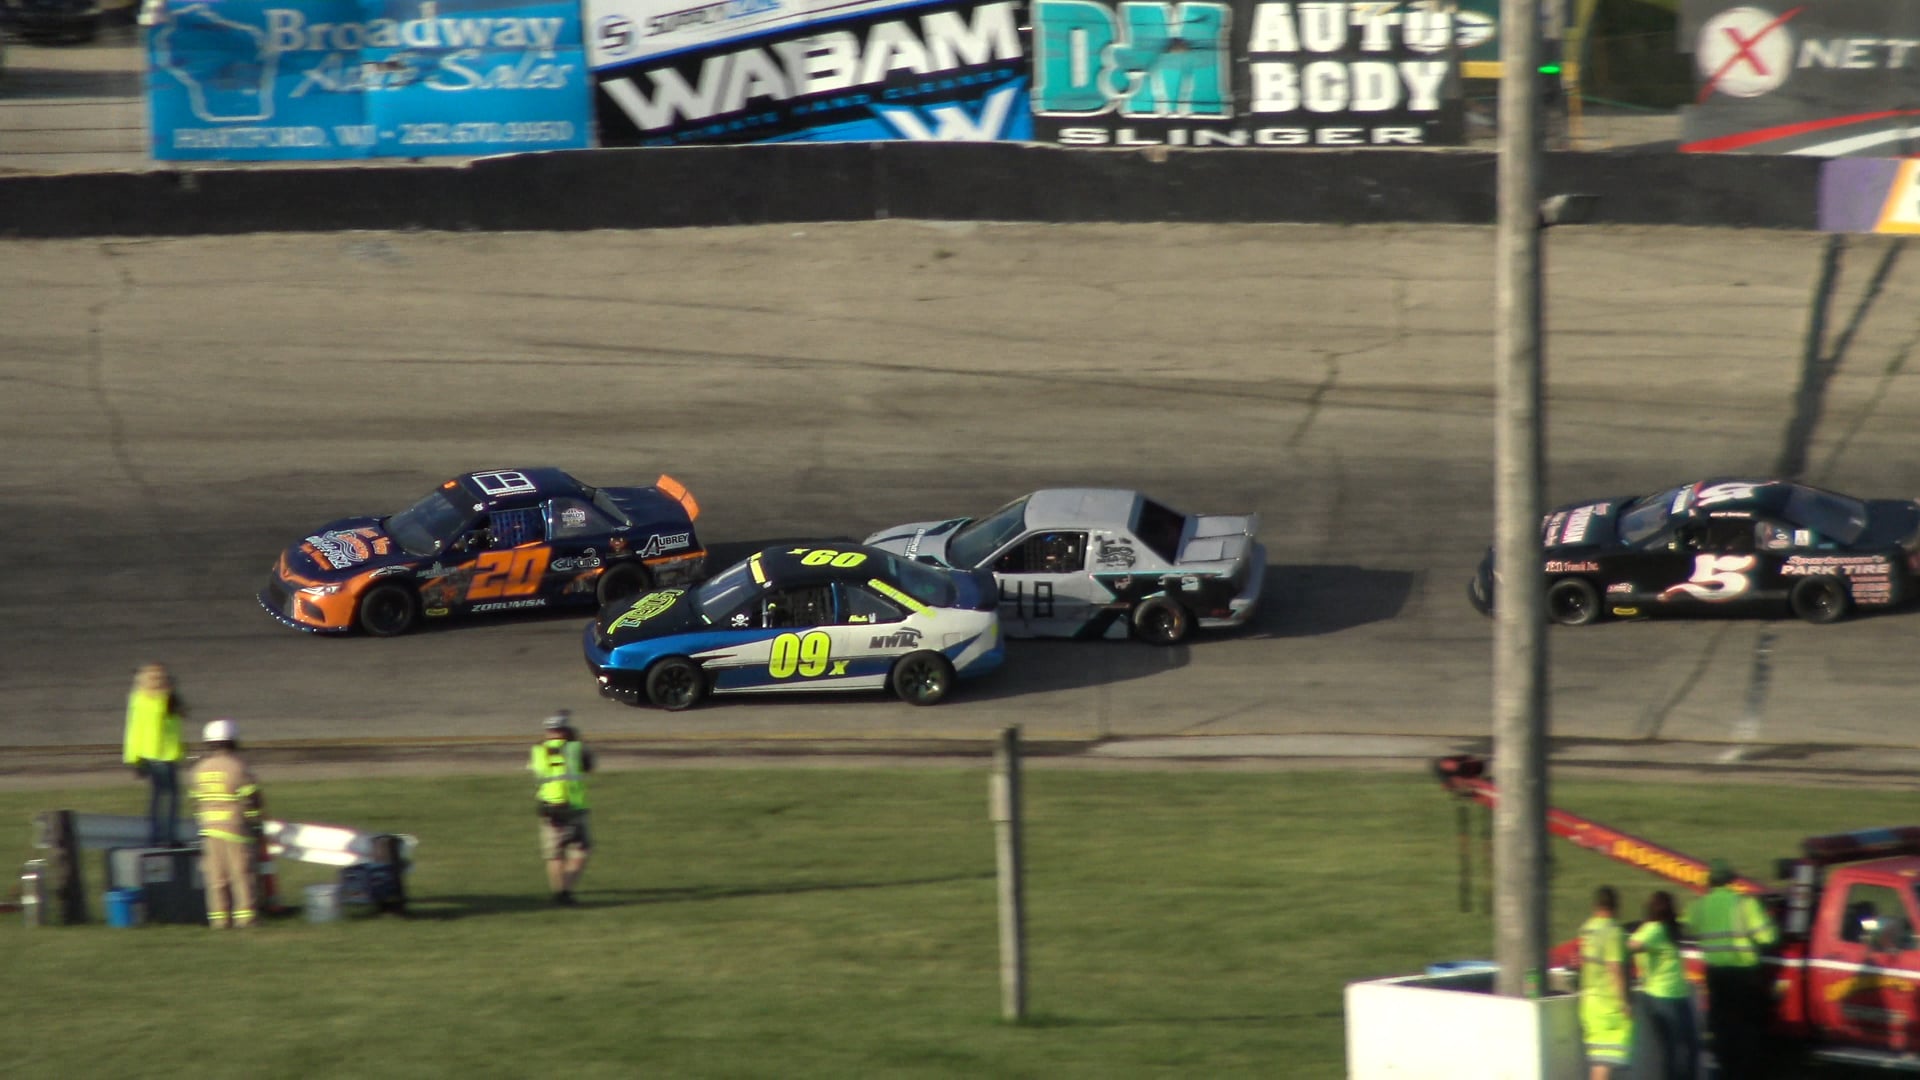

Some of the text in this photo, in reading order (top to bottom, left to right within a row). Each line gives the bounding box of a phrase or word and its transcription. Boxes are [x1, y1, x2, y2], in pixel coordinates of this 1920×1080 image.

[264, 2, 565, 58] Broadway
[602, 2, 1022, 131] WABAM
[1032, 0, 1233, 119] D&M
[1058, 127, 1425, 145] SLINGER
[636, 532, 690, 558] AUBREY
[1780, 563, 1891, 575] PARK TIRE
[466, 547, 551, 600] 20
[1657, 554, 1755, 602] 5
[768, 631, 832, 679] 09
